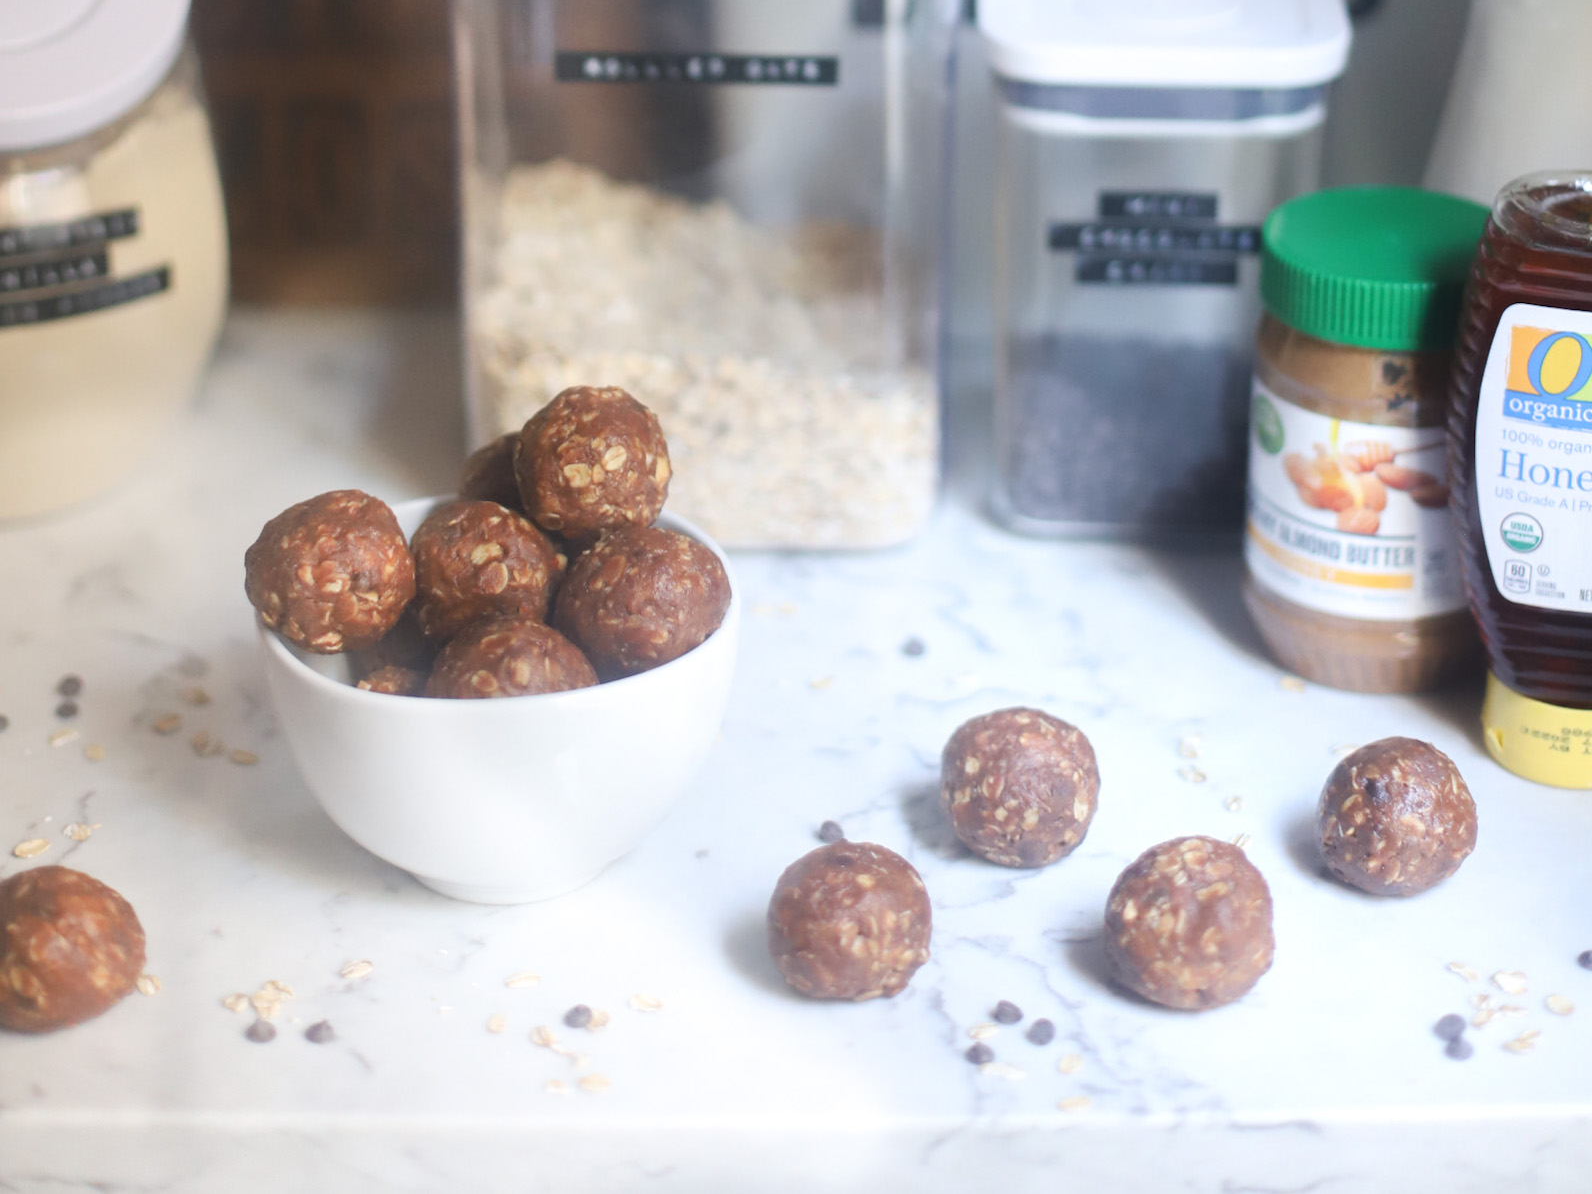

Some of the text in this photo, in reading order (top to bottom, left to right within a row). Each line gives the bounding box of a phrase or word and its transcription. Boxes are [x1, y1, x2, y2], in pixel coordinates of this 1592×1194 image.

[1502, 427, 1544, 447] 100%
[1498, 447, 1592, 492] Hone
[1495, 486, 1514, 500] US
[1517, 490, 1556, 508] Grade
[1559, 498, 1569, 510] A
[1510, 520, 1534, 533] USDA
[1346, 540, 1416, 568] BUTTER
